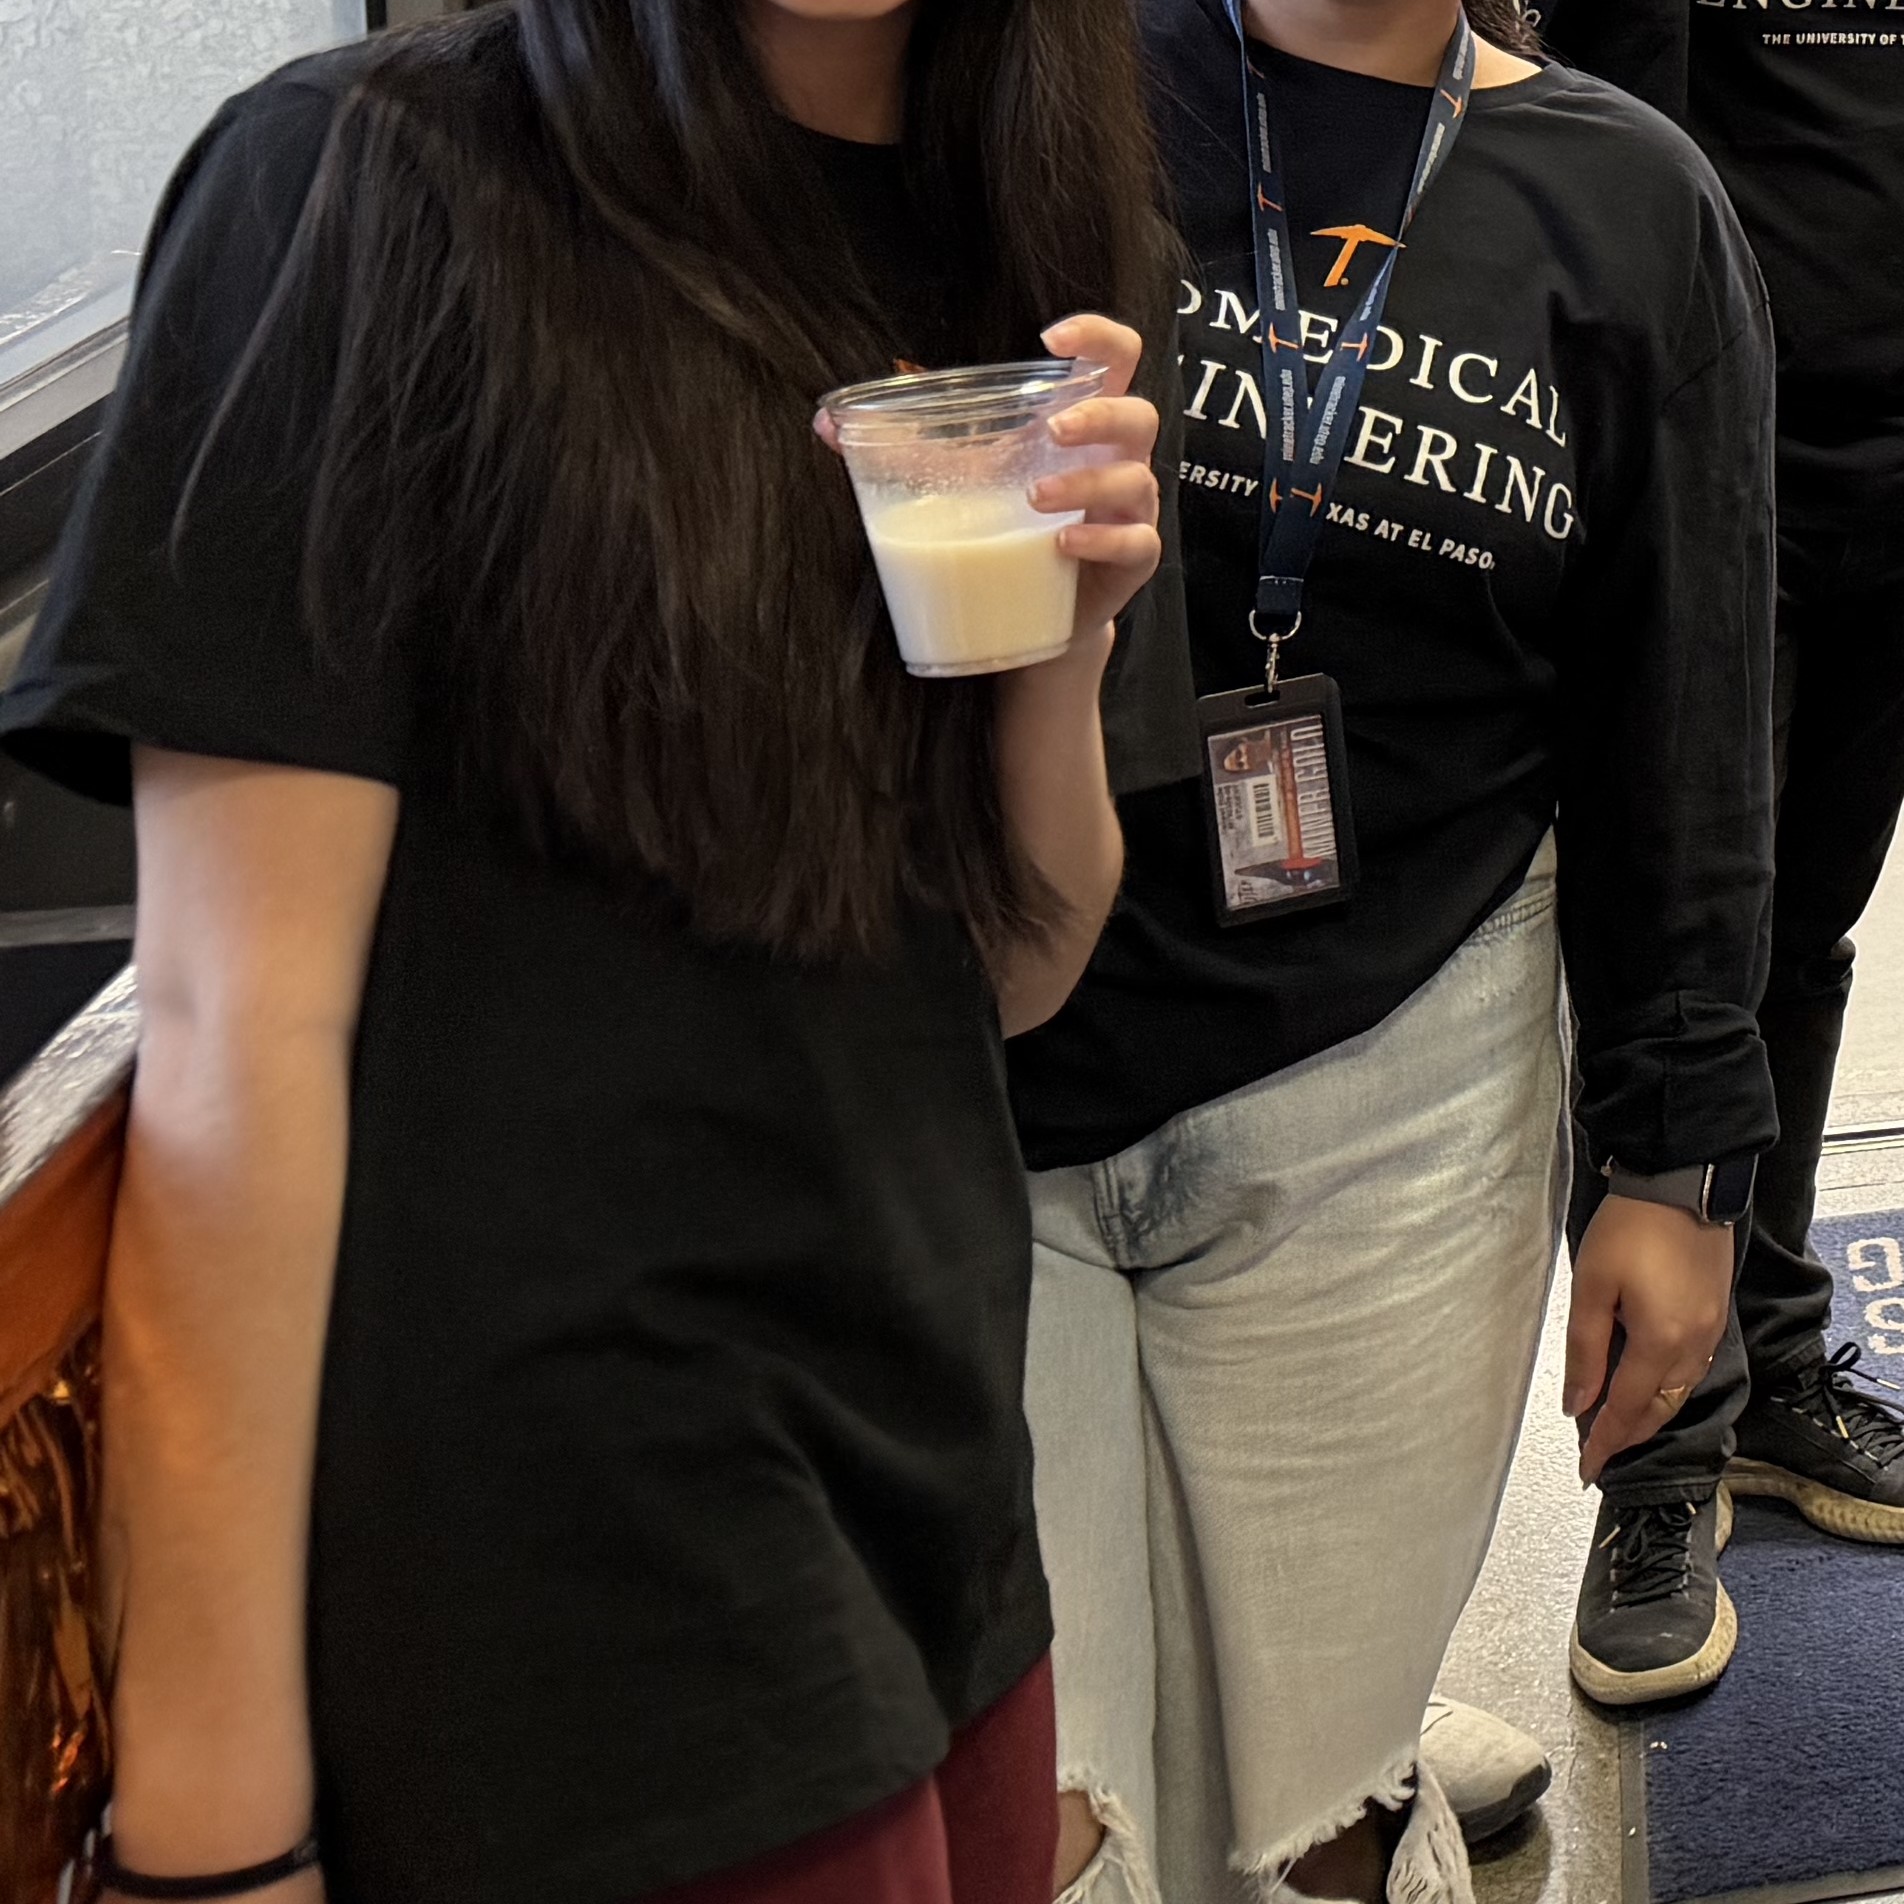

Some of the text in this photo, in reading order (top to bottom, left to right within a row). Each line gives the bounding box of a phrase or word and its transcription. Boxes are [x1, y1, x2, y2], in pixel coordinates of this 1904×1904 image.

[1763, 33, 1790, 45] THE
[1795, 31, 1876, 46] UNIVERSITY
[1879, 34, 1897, 46] OF
[1214, 289, 1567, 448] MEDICAL
[1179, 461, 1492, 569] ERSITY XAS AT EL PASO
[1183, 359, 1575, 541] INERING
